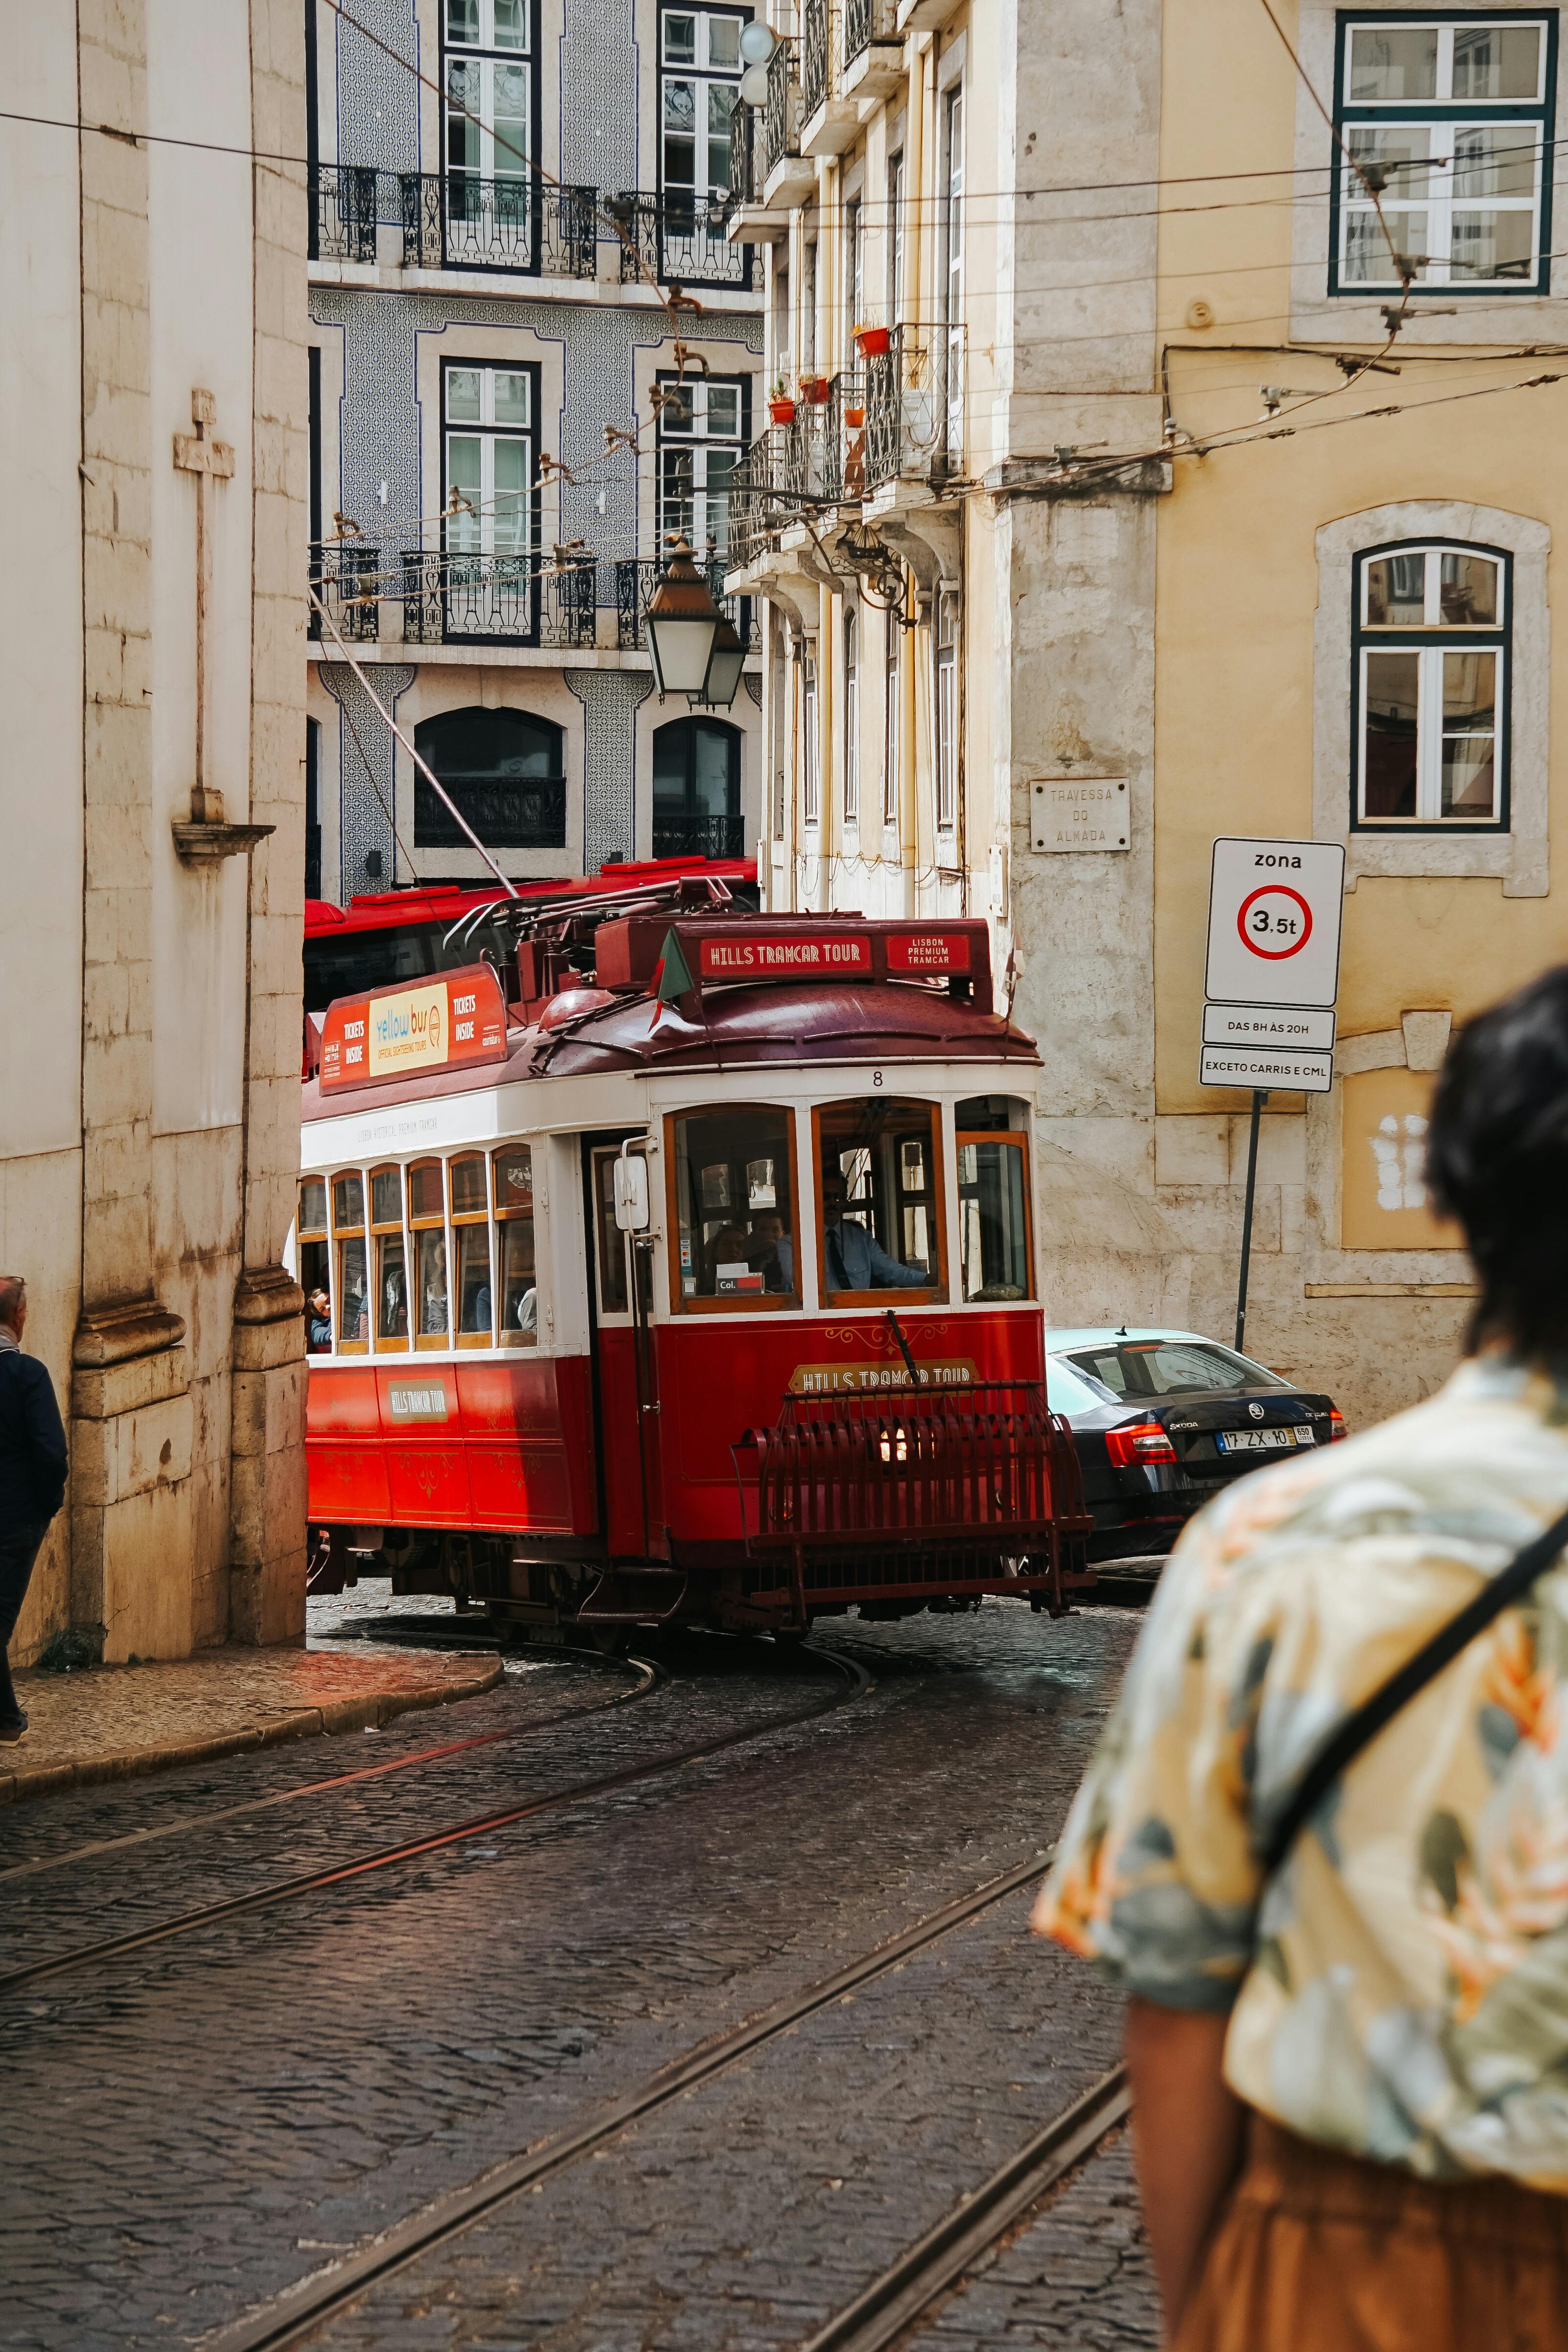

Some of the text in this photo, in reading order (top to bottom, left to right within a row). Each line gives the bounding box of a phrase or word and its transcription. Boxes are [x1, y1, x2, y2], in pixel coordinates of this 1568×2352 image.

[1050, 789, 1113, 801] TRAVESSA
[1073, 810, 1088, 821] DO
[1056, 830, 1106, 842] ALMADA
[1254, 854, 1302, 869] zona
[1252, 910, 1297, 934] 3,5t
[710, 944, 860, 965] HILLS TRAMCAR TOUR
[907, 947, 949, 956] PREMIUM
[907, 956, 950, 964] TRAMCAR
[453, 994, 476, 1016] TICKETS
[344, 1020, 365, 1041] TICKETS
[456, 1021, 474, 1041] INSIDE
[1228, 1022, 1309, 1034] DAS 8H ÀS 20H
[345, 1045, 363, 1064] INSIDE
[1205, 1061, 1327, 1077] EXCETO CARRIS E CML
[873, 1071, 883, 1087] 8
[1170, 1421, 1199, 1430] ŠKODA
[1297, 1427, 1309, 1436] 650
